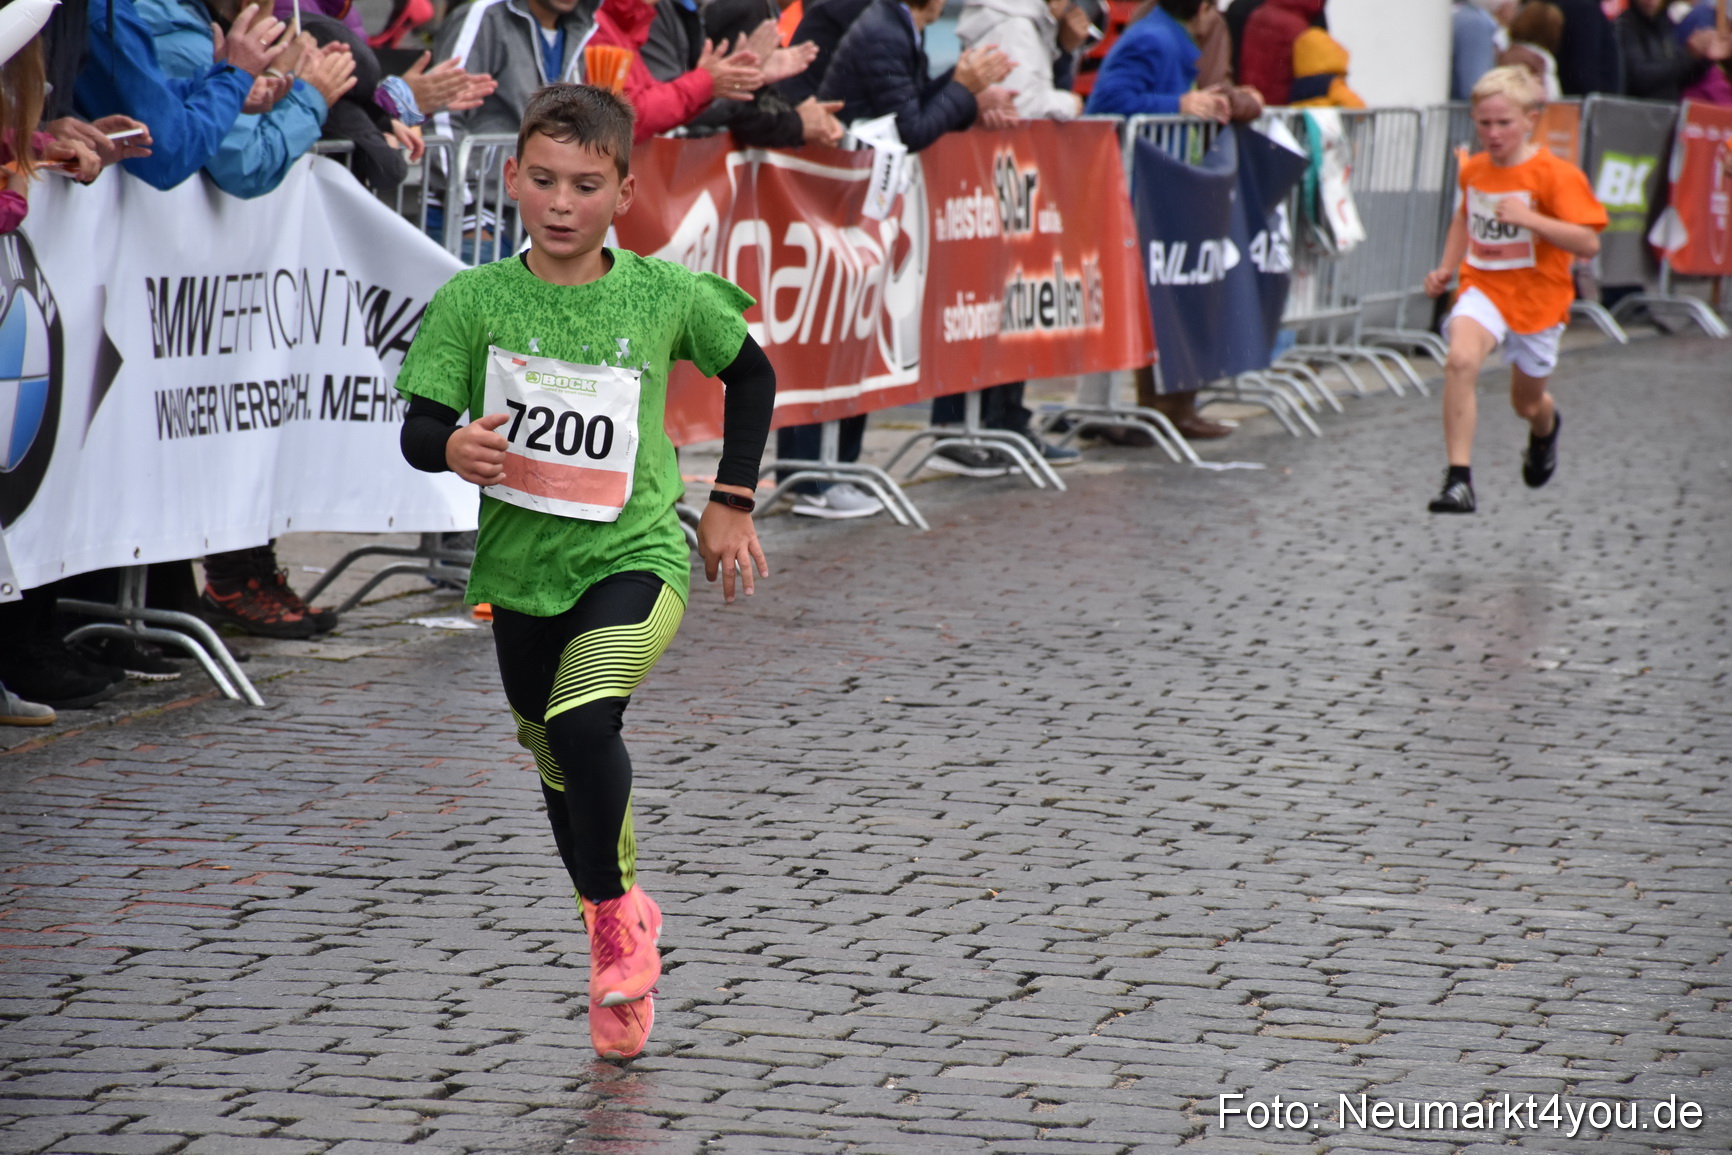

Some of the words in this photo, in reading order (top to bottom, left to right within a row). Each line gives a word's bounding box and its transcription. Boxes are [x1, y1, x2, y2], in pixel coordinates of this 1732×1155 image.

[145, 276, 219, 359] BMW
[541, 373, 597, 392] BOCK
[506, 398, 614, 460] 7200
